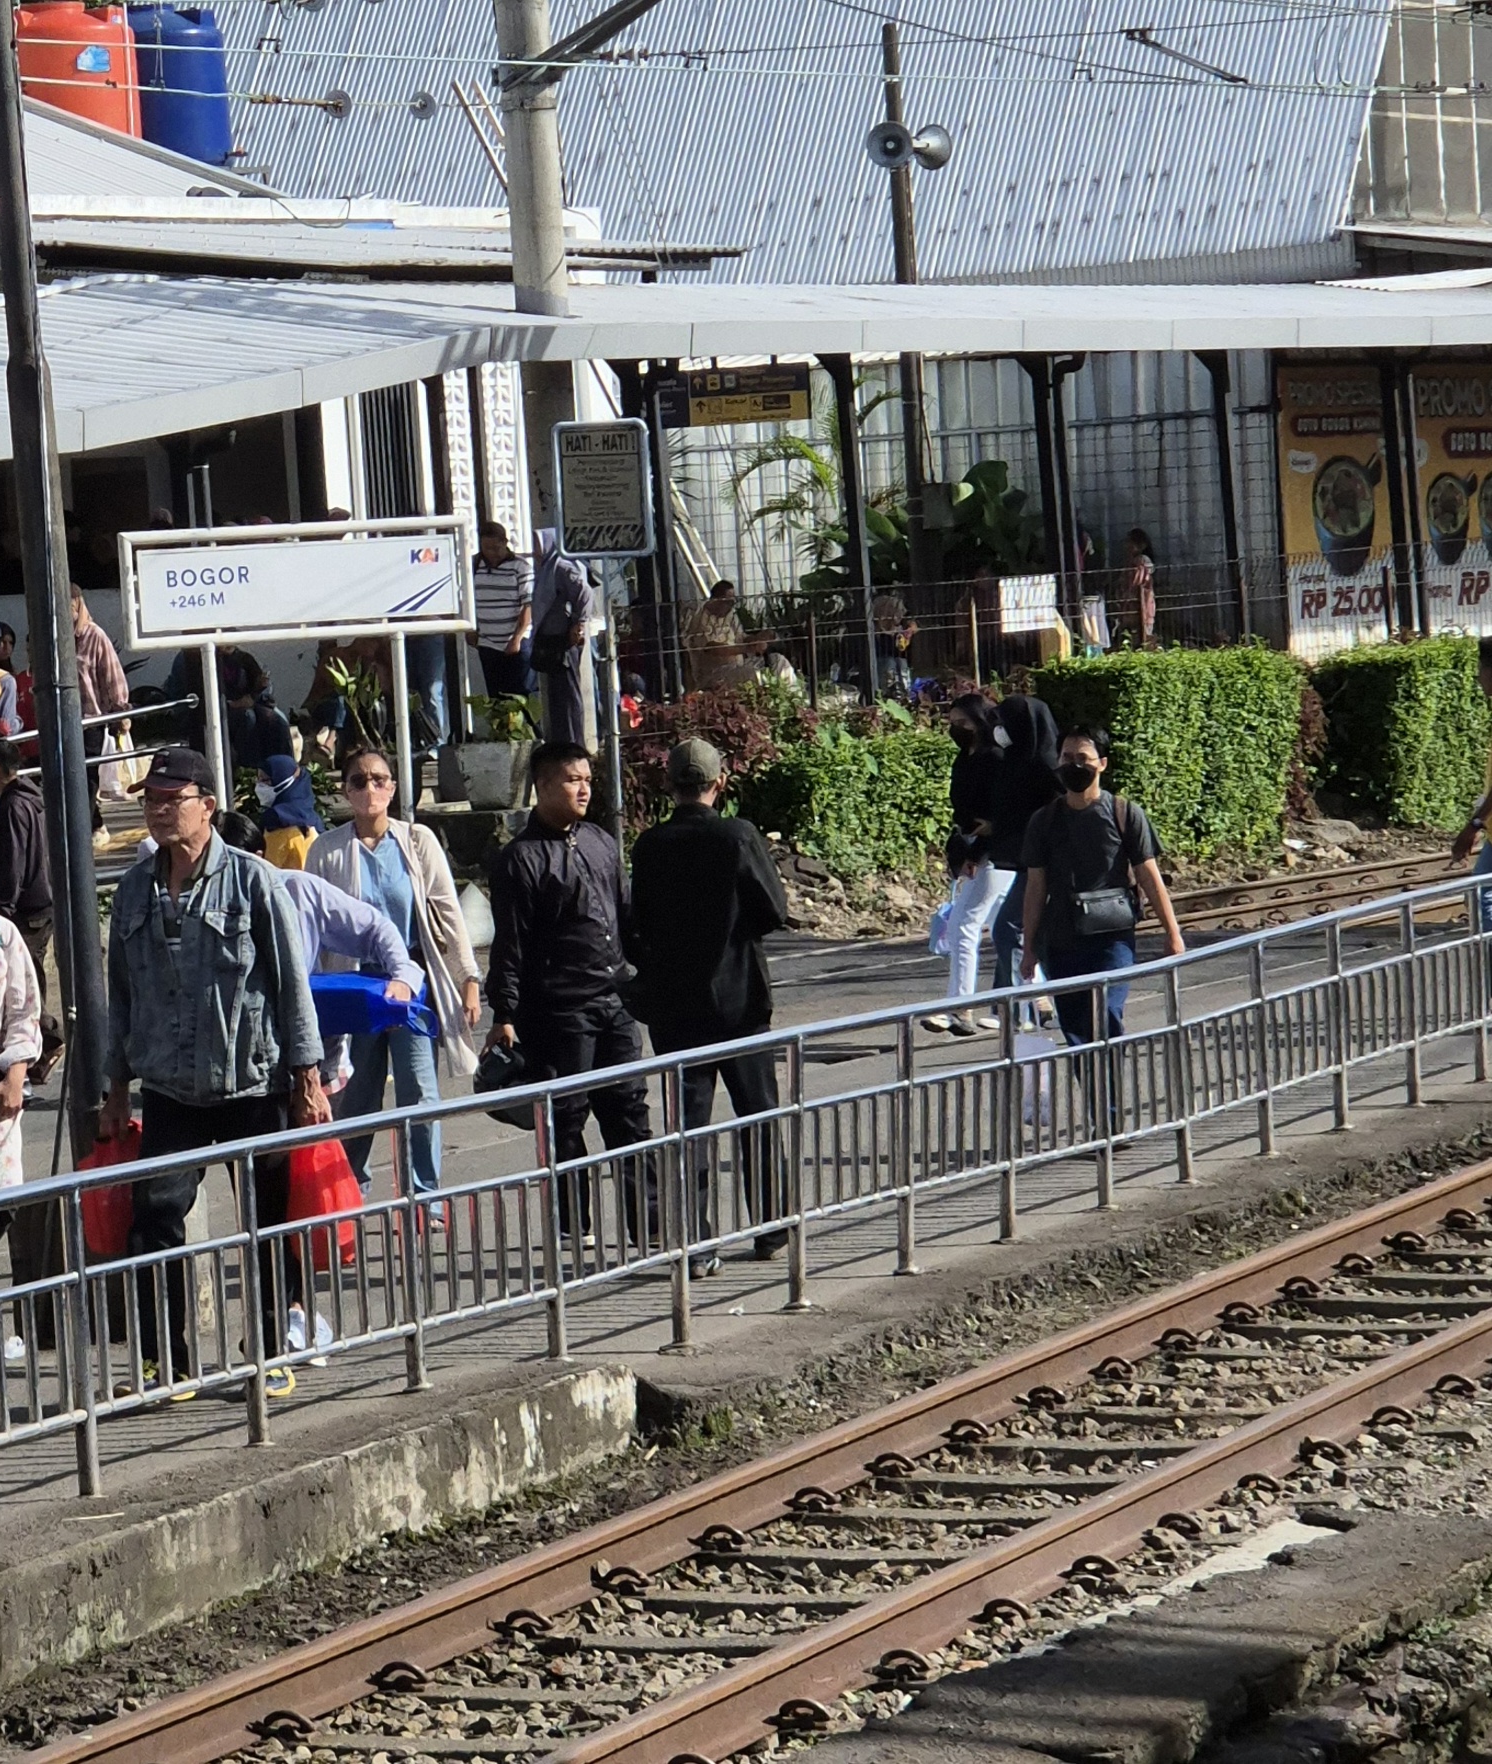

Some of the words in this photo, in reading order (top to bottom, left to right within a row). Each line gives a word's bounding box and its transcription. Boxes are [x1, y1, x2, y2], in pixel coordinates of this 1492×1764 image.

[1416, 378, 1485, 417] PROMO
[565, 435, 592, 452] HATI
[602, 434, 628, 451] HATI
[166, 566, 250, 588] BOGOR
[1458, 571, 1490, 606] RP
[169, 593, 206, 608] +246
[211, 592, 225, 605] M
[1301, 588, 1327, 619] RP
